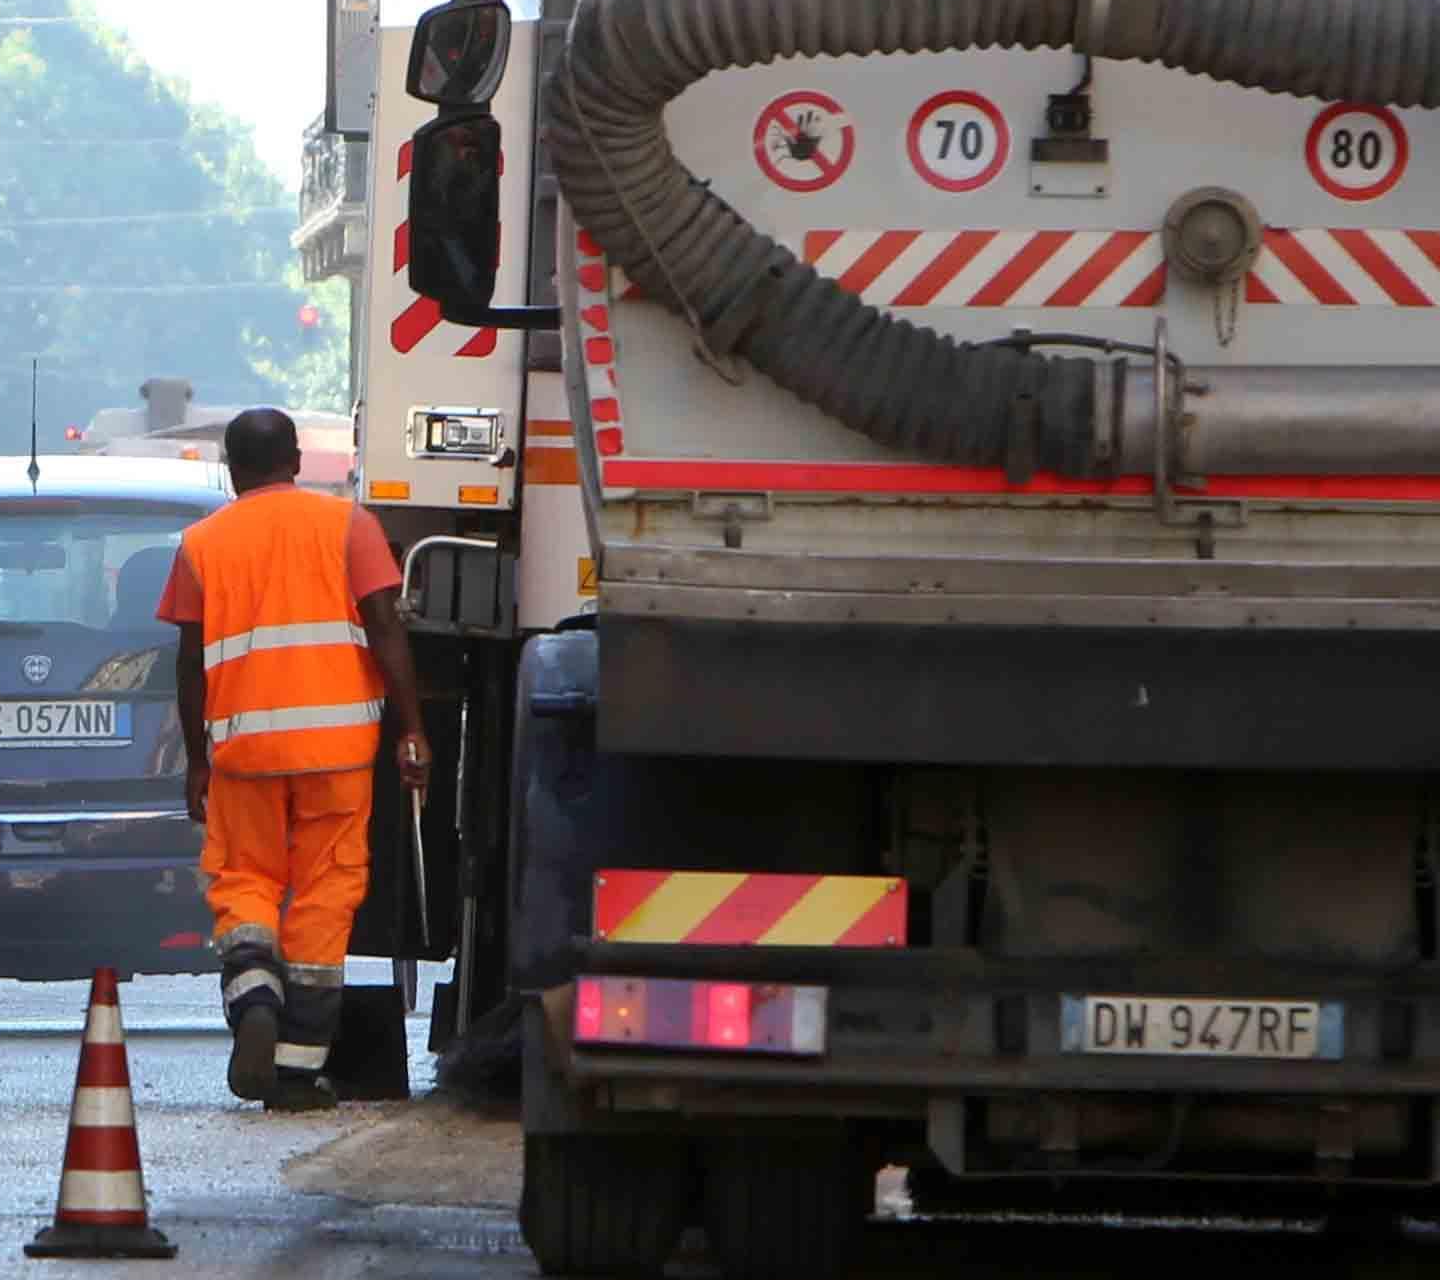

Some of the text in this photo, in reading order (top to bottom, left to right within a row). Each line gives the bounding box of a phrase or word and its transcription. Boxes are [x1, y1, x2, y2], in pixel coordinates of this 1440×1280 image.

[936, 120, 983, 160] 70
[1331, 129, 1381, 170] 80
[16, 704, 112, 734] 057NN
[1093, 1002, 1313, 1053] DW 947RF
